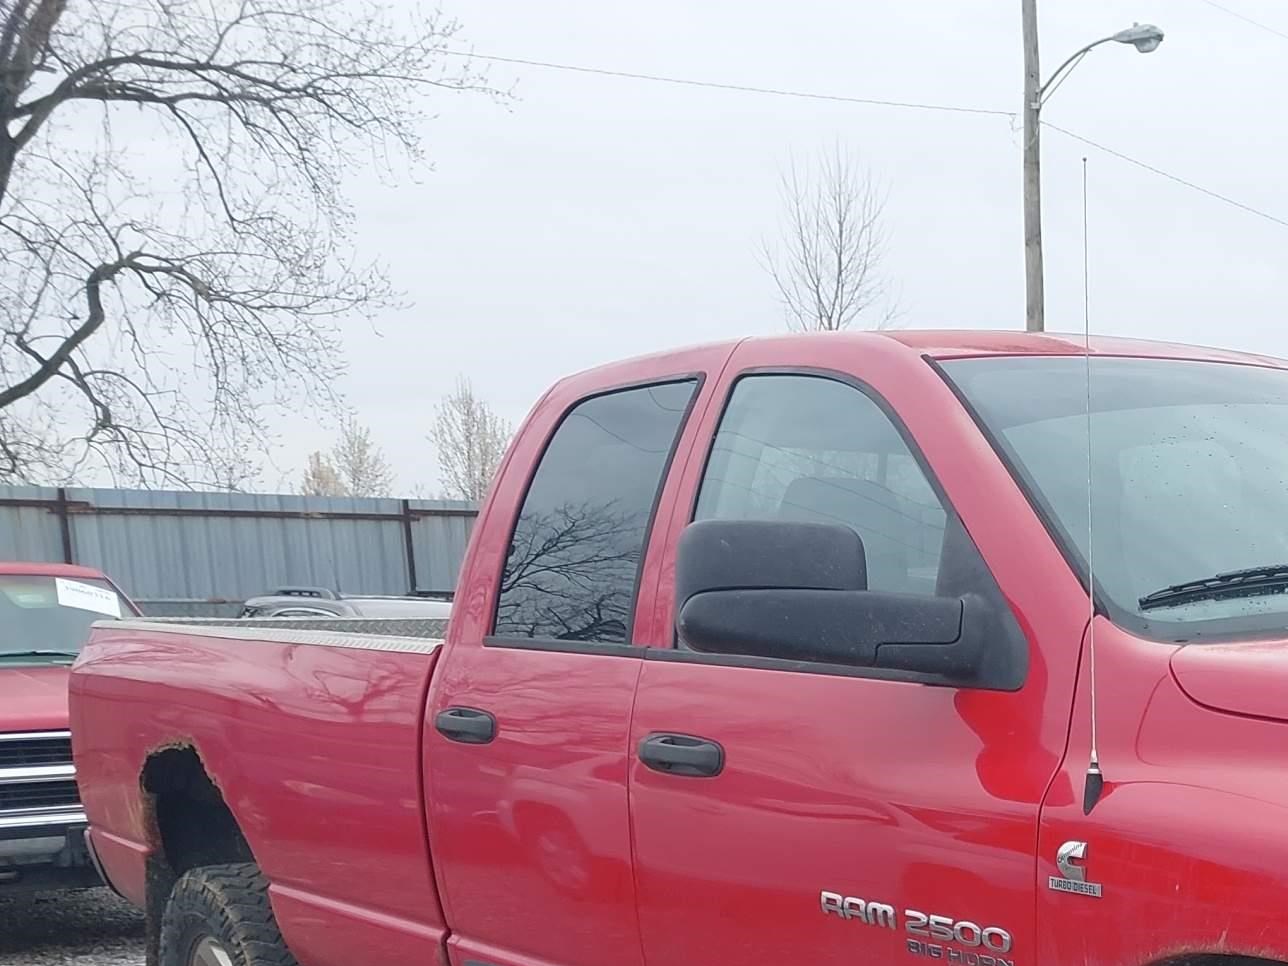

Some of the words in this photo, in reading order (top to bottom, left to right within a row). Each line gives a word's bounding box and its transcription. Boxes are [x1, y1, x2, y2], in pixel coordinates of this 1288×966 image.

[1050, 878, 1072, 890] TURBO
[1073, 882, 1098, 895] DIESEL
[821, 890, 897, 930] RAM
[904, 909, 1013, 953] 2500
[906, 938, 944, 960] BIG
